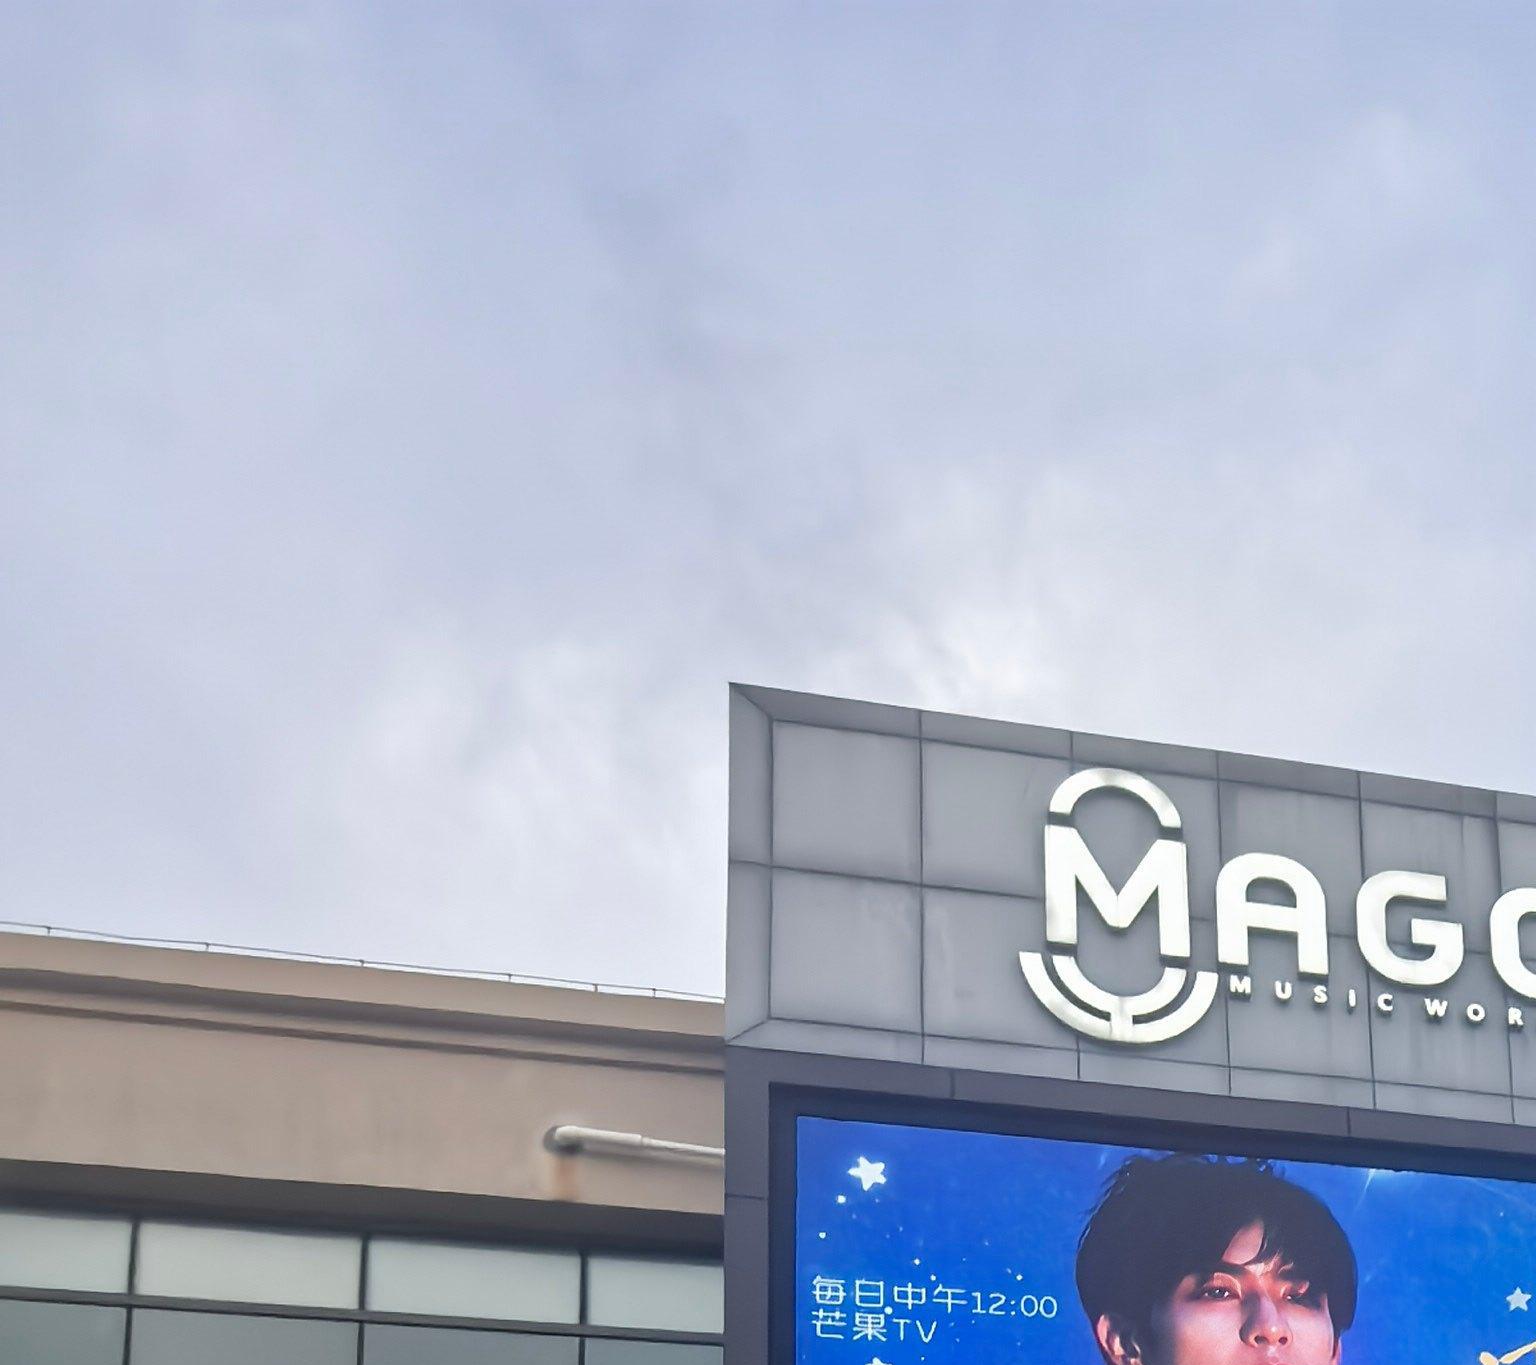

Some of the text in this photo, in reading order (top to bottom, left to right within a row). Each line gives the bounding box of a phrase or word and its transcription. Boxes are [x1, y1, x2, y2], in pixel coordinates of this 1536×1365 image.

[1229, 973, 1394, 1013] MUSIC
[812, 1275, 1058, 1318] 每日中午12:00
[811, 1308, 938, 1343] 芒果TV
